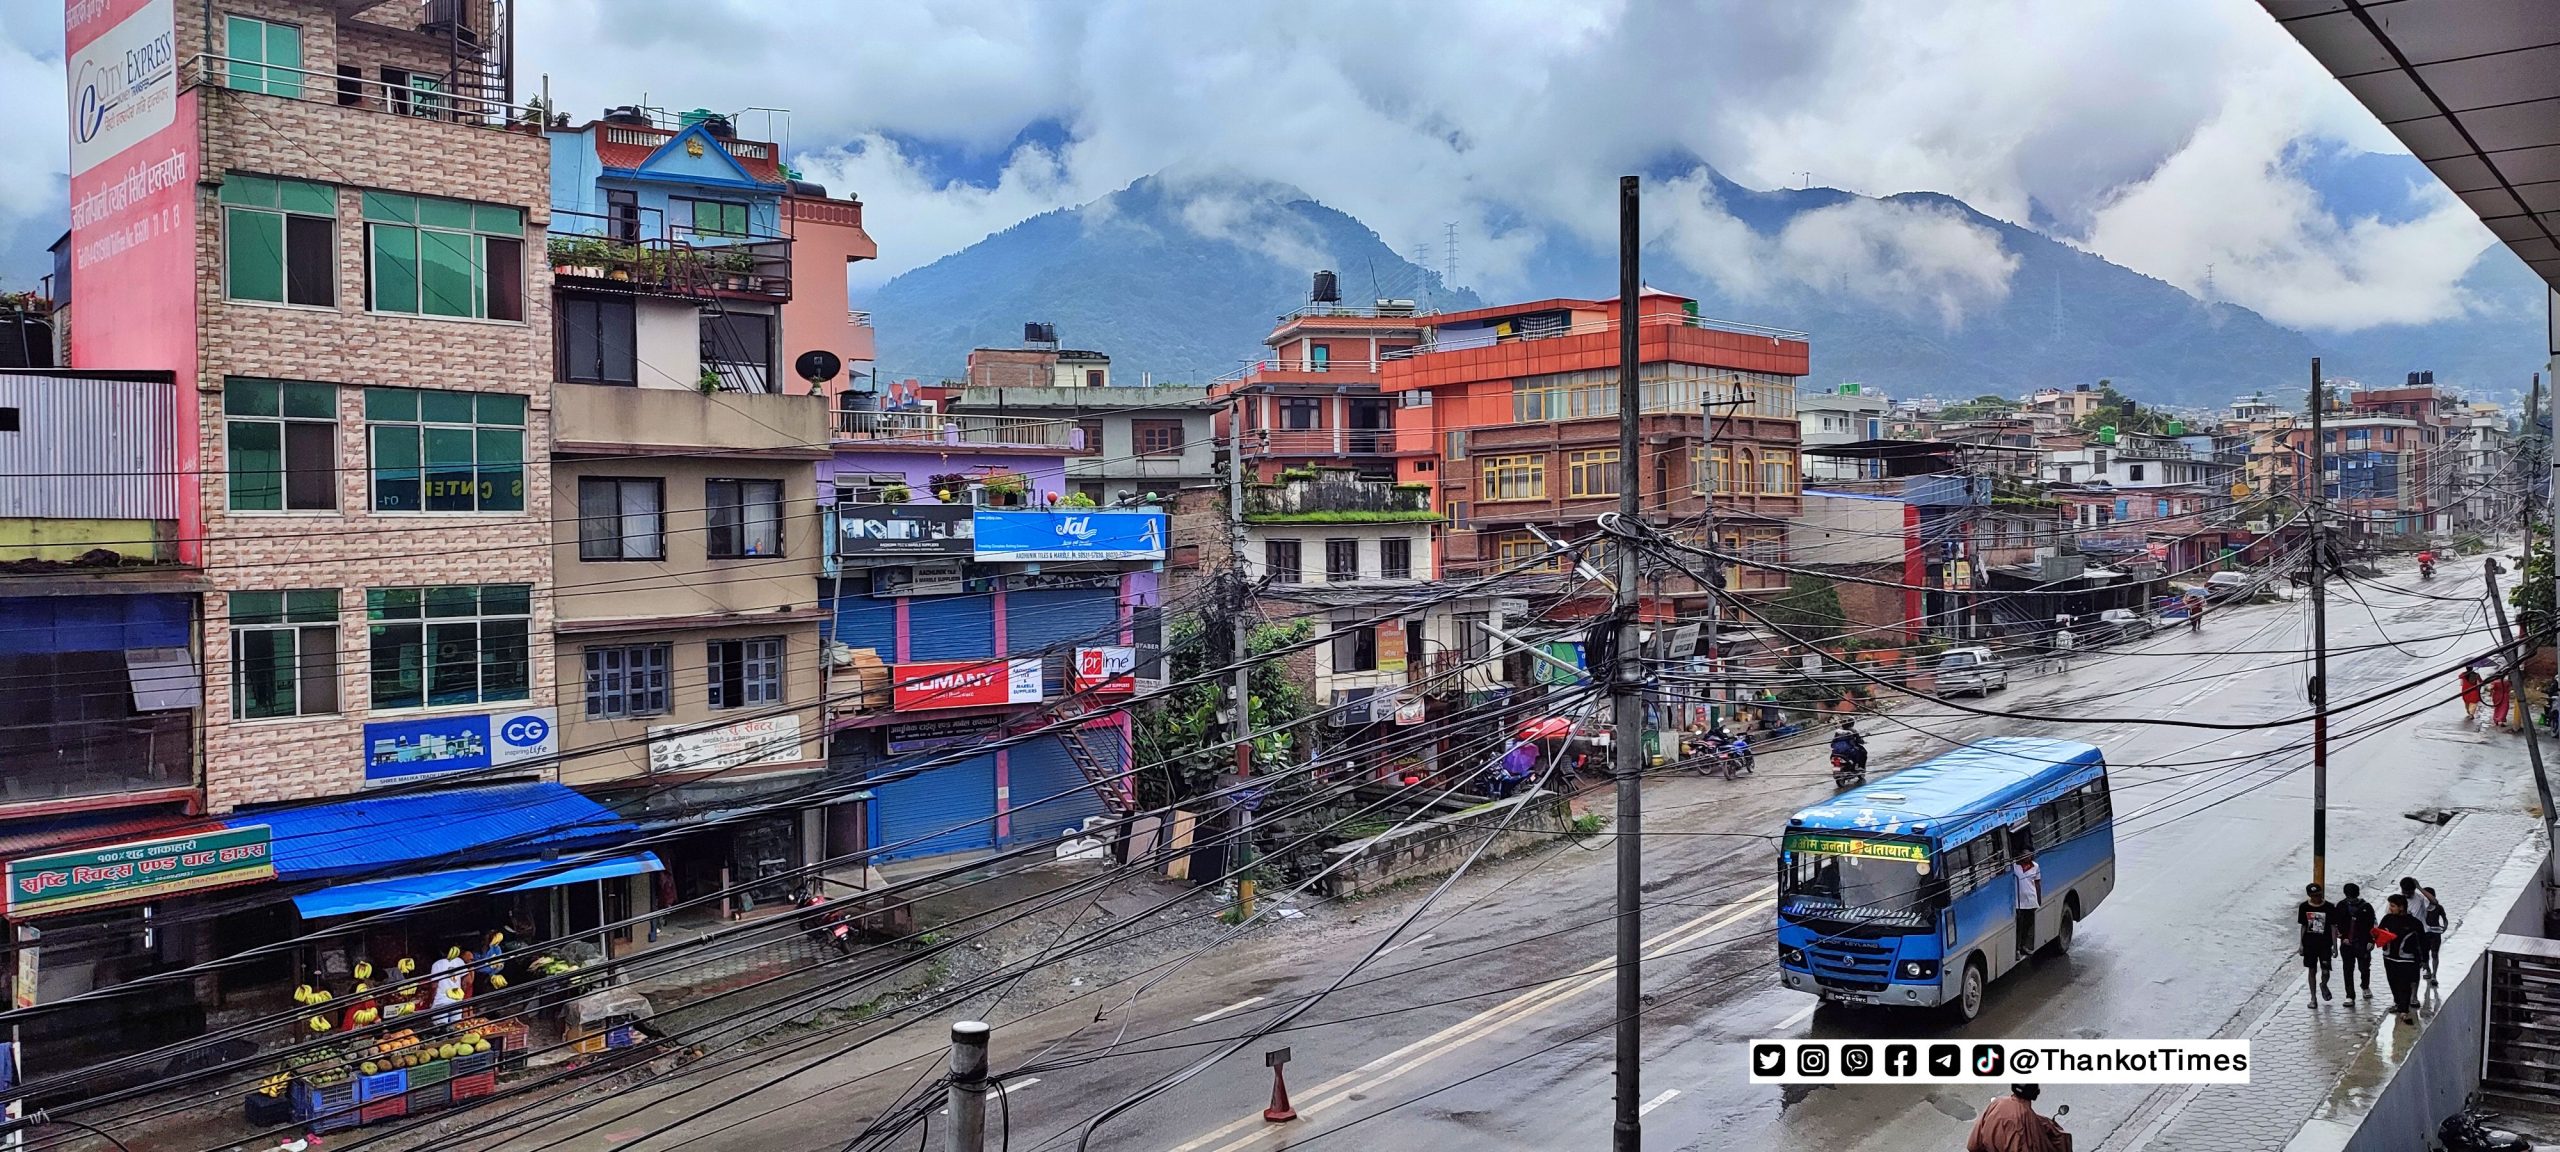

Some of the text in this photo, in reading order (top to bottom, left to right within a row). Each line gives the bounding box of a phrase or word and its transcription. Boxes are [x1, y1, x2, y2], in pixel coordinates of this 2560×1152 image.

[96, 31, 171, 102] CITY EXPRESS
[147, 148, 185, 194] एक्सप्रेस
[1056, 516, 1096, 538] Jal
[507, 721, 544, 741] CG
[147, 839, 197, 856] शाकाहारी
[1820, 840, 1850, 853] जनता
[1863, 843, 1911, 858] यातायात
[20, 871, 68, 894] सृष्टि
[72, 863, 134, 884] स्विट्स
[139, 855, 178, 874] एण्ड
[182, 850, 216, 867] चाट
[219, 843, 267, 862] हाउस
